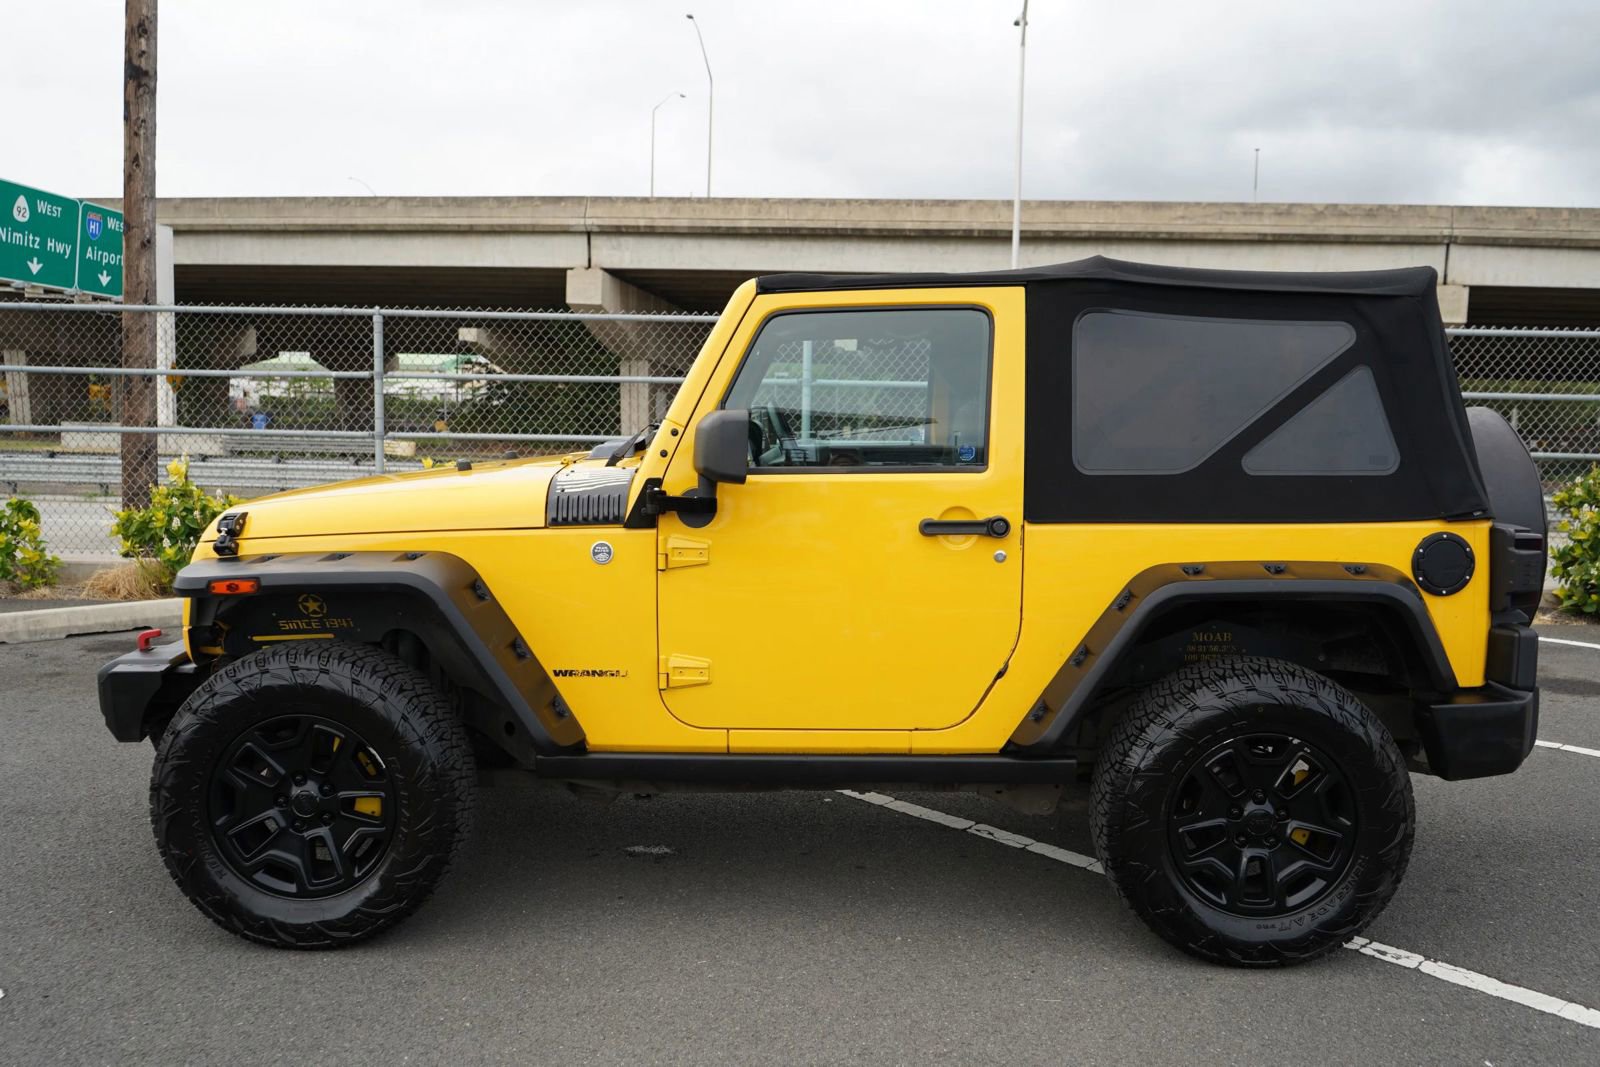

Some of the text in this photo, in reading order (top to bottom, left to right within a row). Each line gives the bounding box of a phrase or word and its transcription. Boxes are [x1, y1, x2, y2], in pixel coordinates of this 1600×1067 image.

[16, 200, 62, 218] 92 WEST
[107, 216, 123, 232] WES
[0, 227, 72, 259] Nimitz Hwy
[323, 618, 354, 628] 1941
[1192, 632, 1233, 642] MOAB
